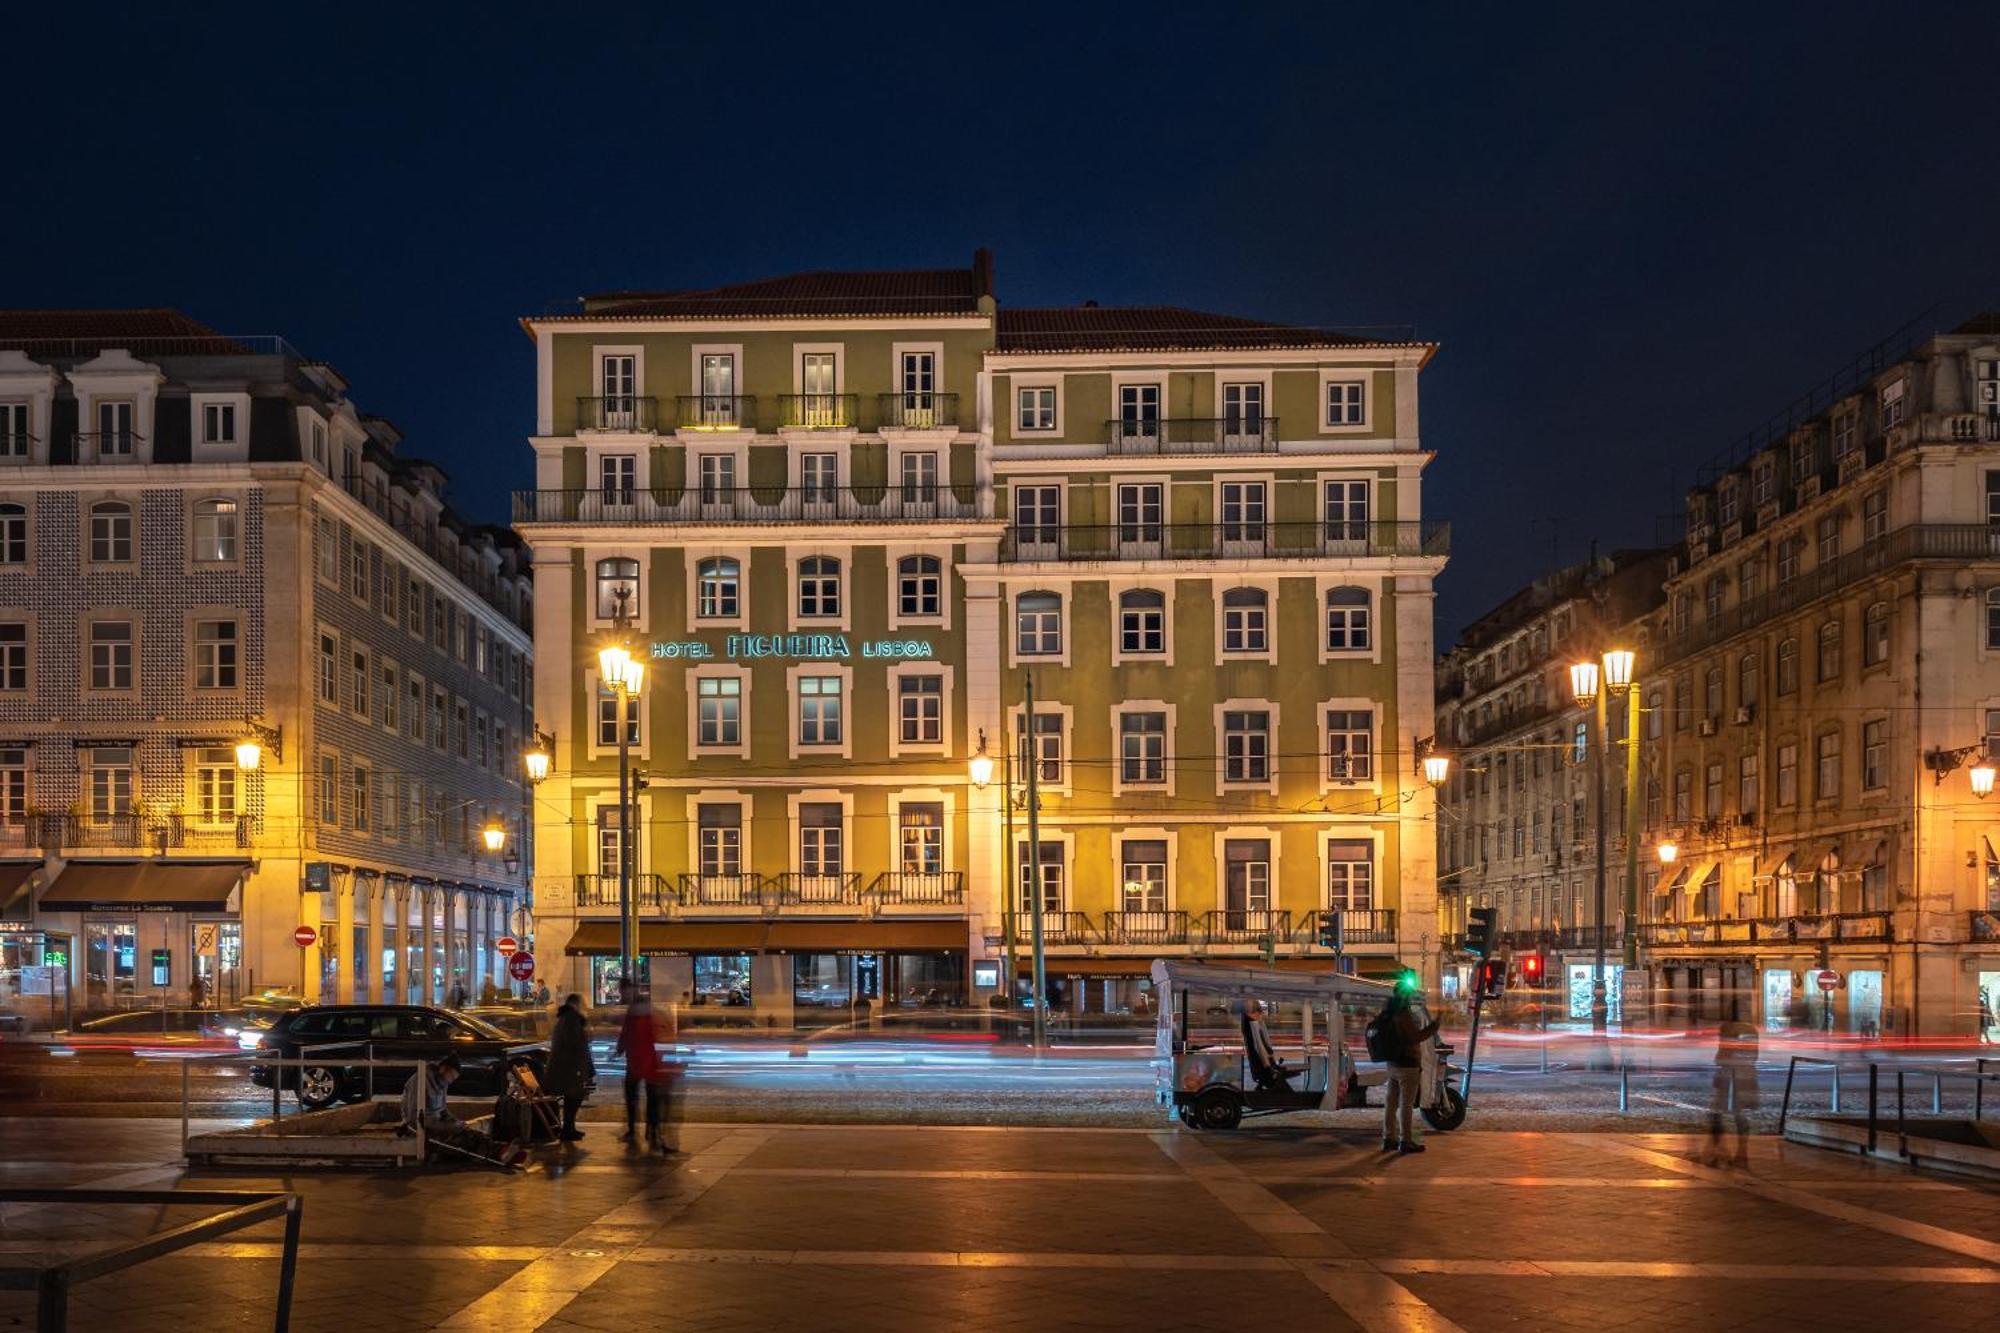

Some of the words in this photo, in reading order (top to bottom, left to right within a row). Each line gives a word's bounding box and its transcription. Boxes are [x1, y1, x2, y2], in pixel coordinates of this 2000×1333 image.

[651, 642, 714, 658] HOTEL
[726, 634, 850, 658] FIGUEIRA
[863, 640, 932, 657] LISBOA
